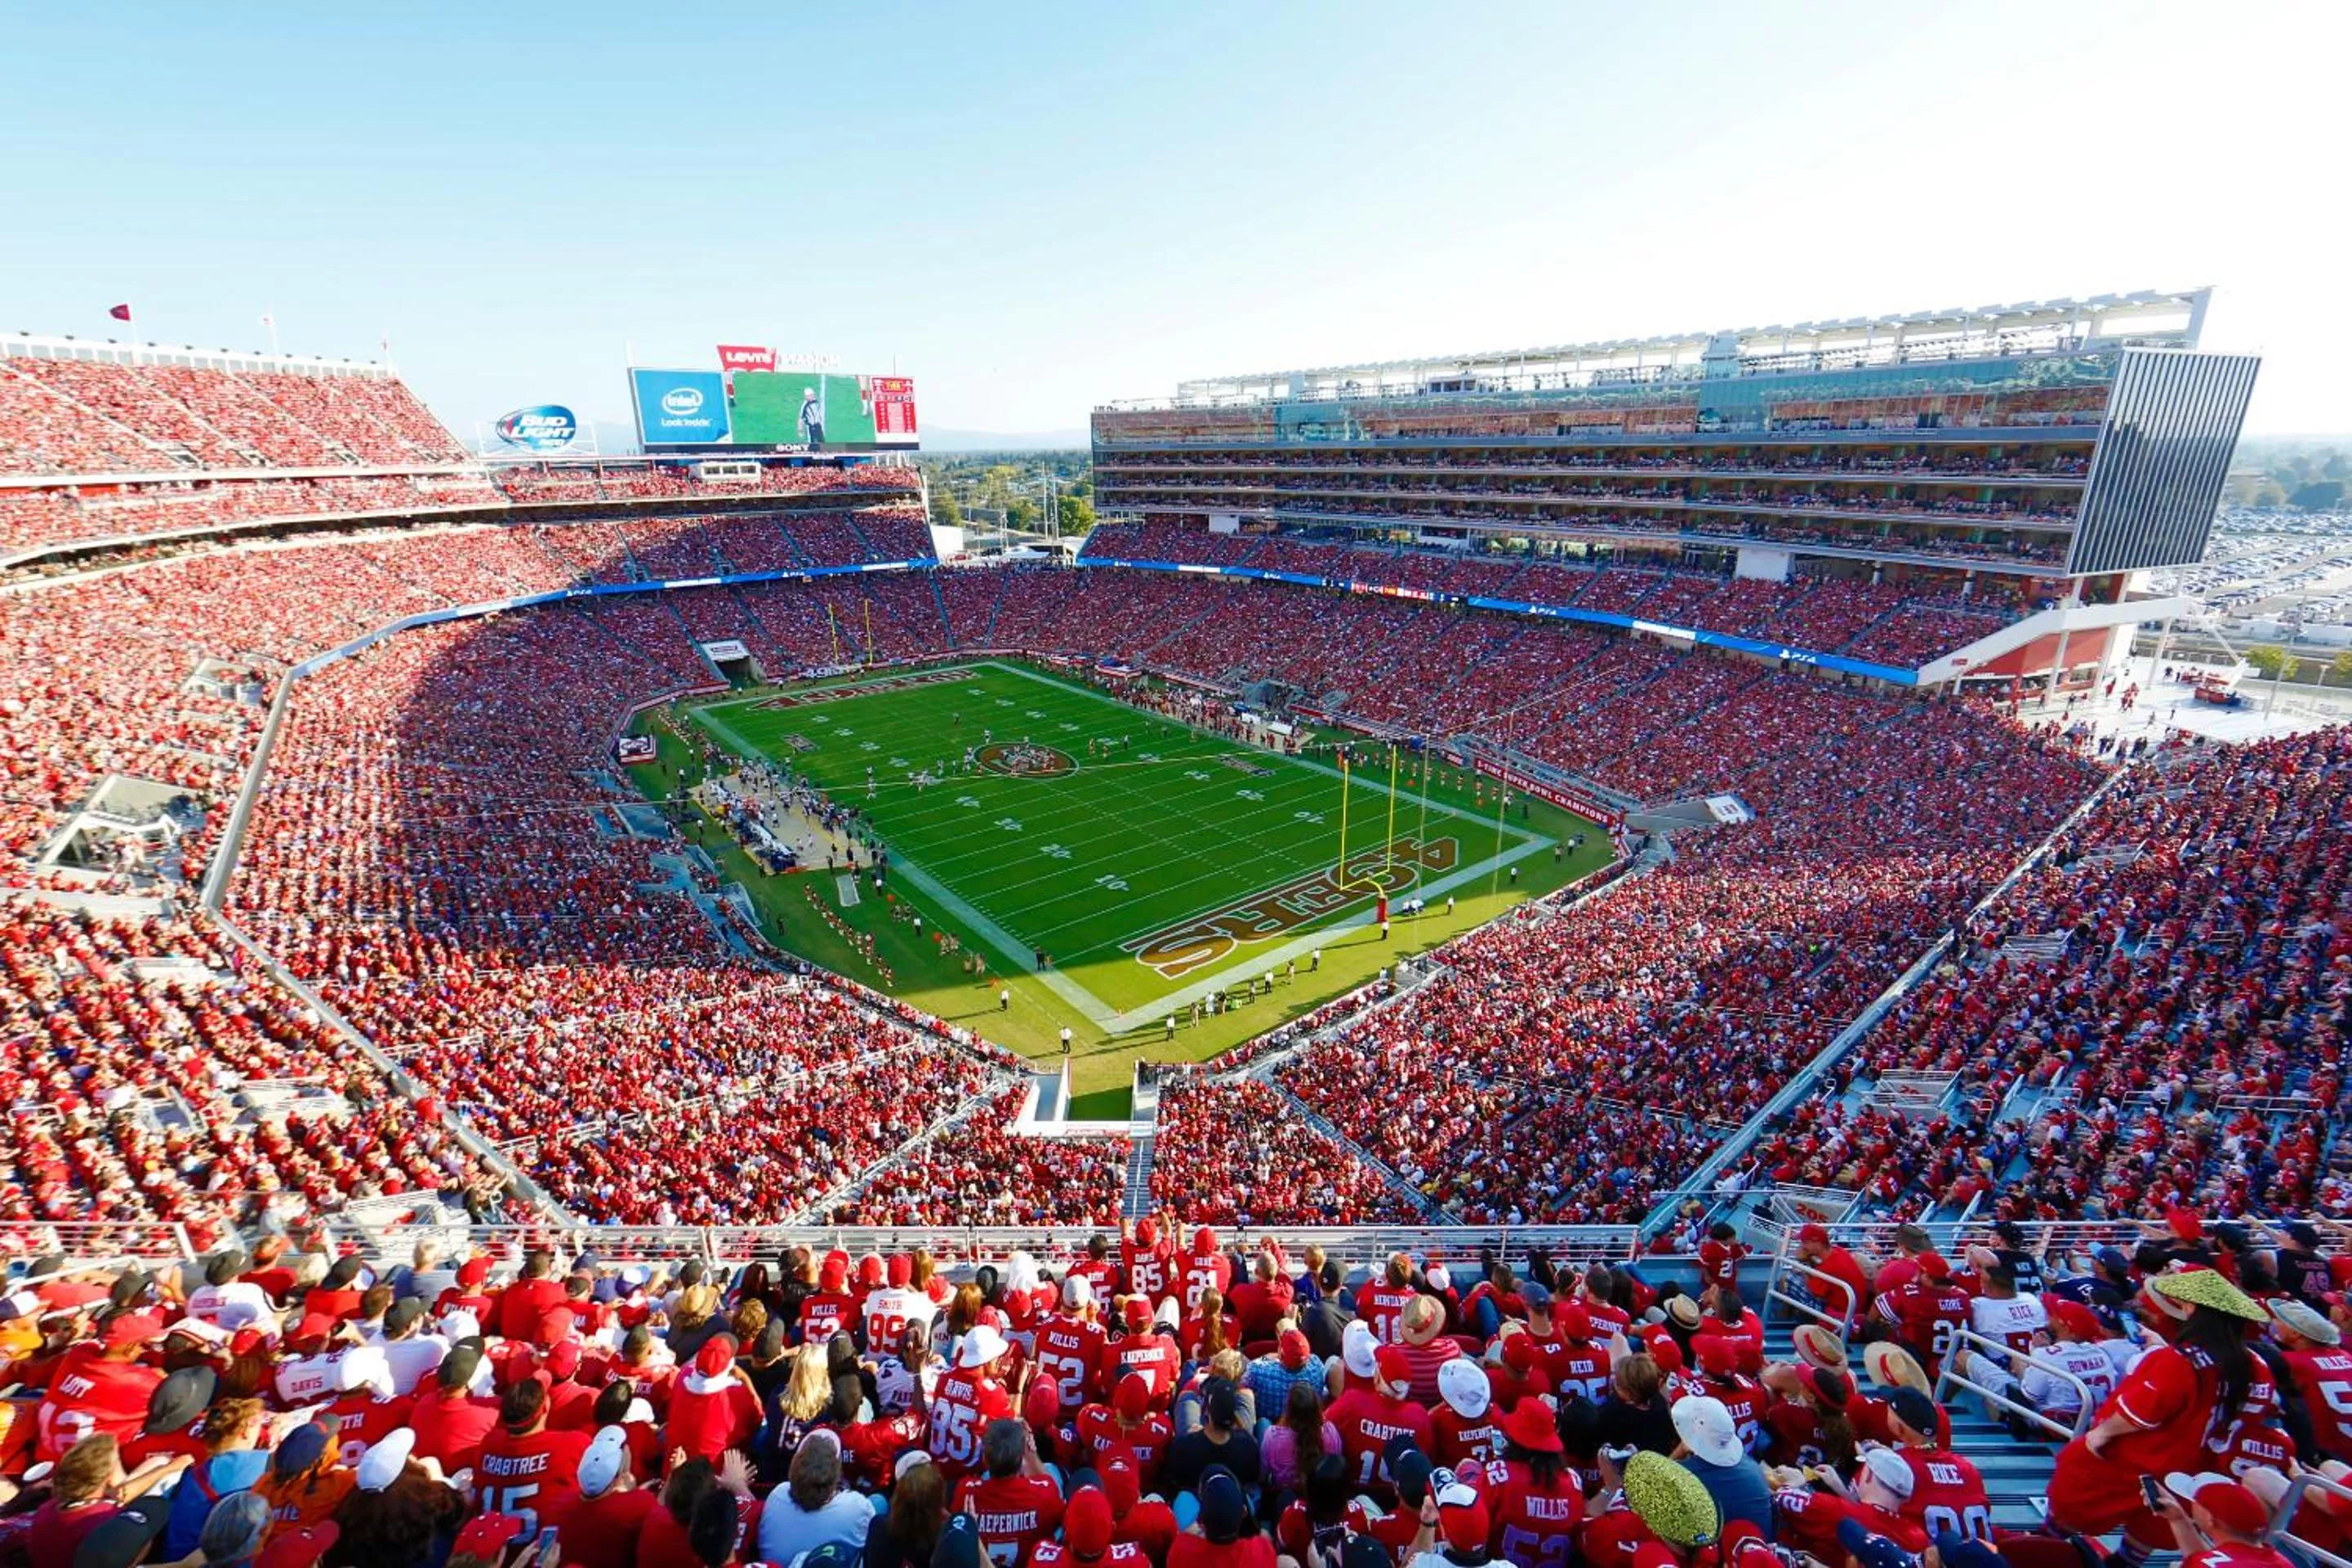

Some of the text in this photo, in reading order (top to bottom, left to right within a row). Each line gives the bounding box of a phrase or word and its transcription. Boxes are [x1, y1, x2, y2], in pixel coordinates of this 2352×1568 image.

[667, 394, 697, 407] intel
[520, 415, 568, 426] BUD
[511, 427, 575, 439] LIGHT
[777, 443, 809, 452] SONY
[1530, 782, 1552, 800] BOWL
[1554, 795, 1608, 823] CHAMPIONS
[1134, 837, 1459, 980] 49ERS
[1132, 1263, 1163, 1295] 85
[811, 1304, 838, 1316] WILLIS
[804, 1316, 841, 1342] 52
[868, 1313, 906, 1355] 99
[1047, 1330, 1080, 1349] WILLIS
[1569, 1360, 1594, 1374] REID
[778, 1414, 804, 1451] 15
[929, 1396, 978, 1461] 85
[2241, 1438, 2284, 1460] WILLIS
[482, 1452, 551, 1477] CRABTREE
[1927, 1463, 1964, 1486] RICE
[482, 1482, 540, 1546] 15
[1526, 1495, 1570, 1519] WILLIS
